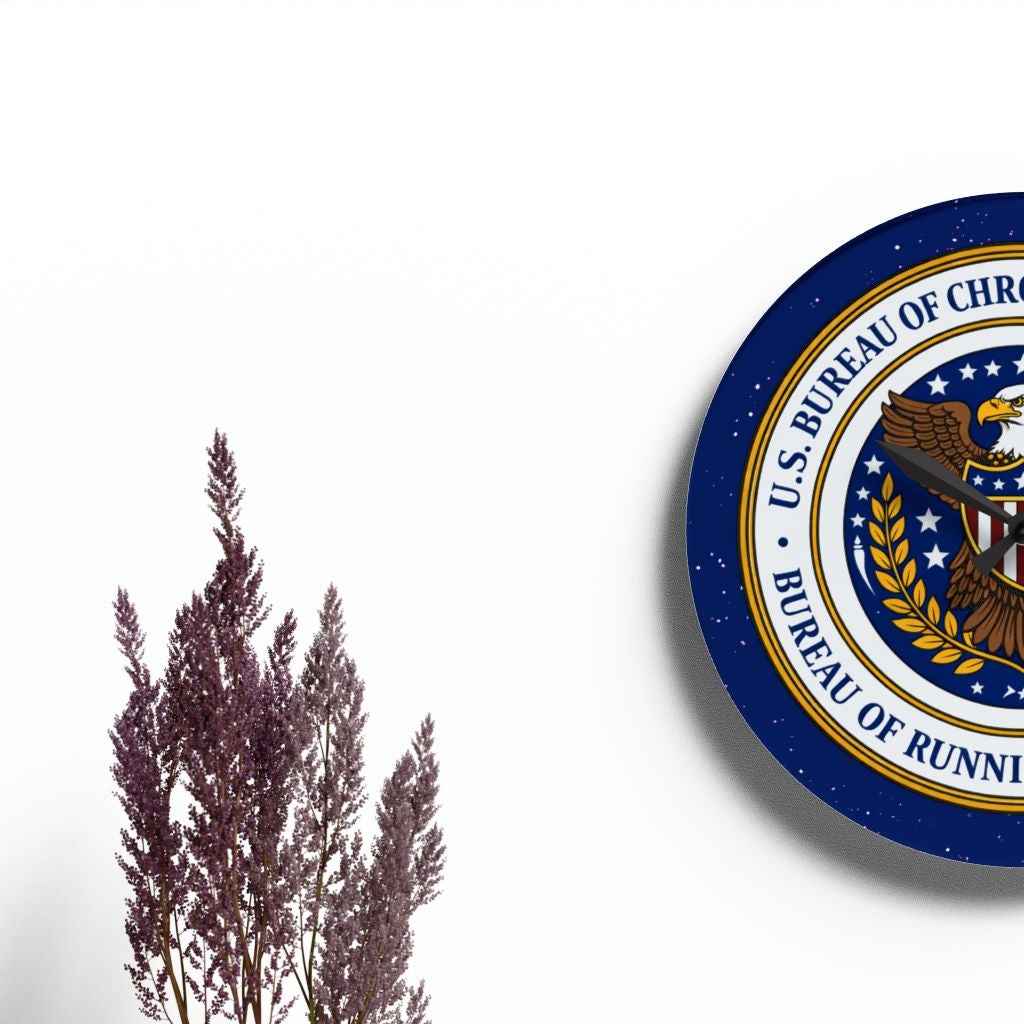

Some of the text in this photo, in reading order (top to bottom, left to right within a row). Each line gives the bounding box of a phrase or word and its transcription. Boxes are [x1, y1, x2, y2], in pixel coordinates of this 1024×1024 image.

[898, 290, 939, 331] OF
[789, 314, 898, 439] BUREAU
[768, 445, 812, 509] U.S.
[772, 567, 863, 705] BUREAU
[857, 702, 906, 744] OF
